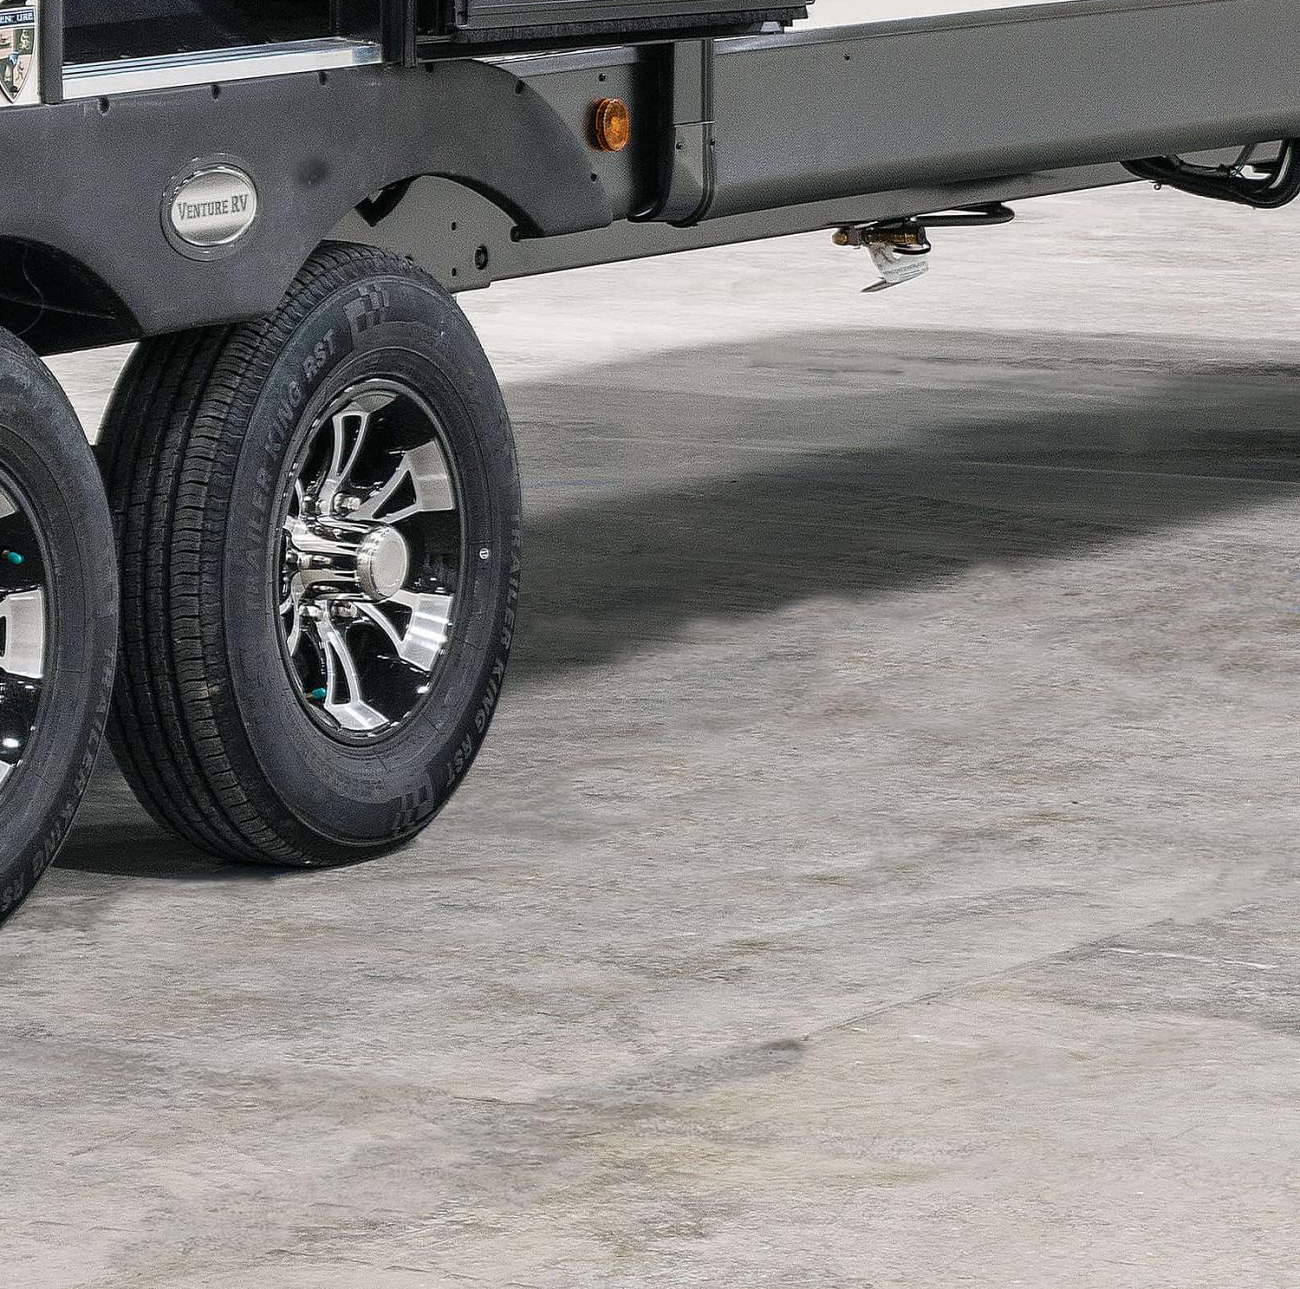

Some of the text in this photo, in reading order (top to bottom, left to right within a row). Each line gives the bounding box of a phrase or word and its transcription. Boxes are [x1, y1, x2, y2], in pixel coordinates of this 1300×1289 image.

[177, 194, 249, 221] VENTURE RV
[264, 379, 303, 460] KING
[301, 329, 336, 381] RST
[474, 657, 505, 734] KING
[446, 733, 474, 788] RST
